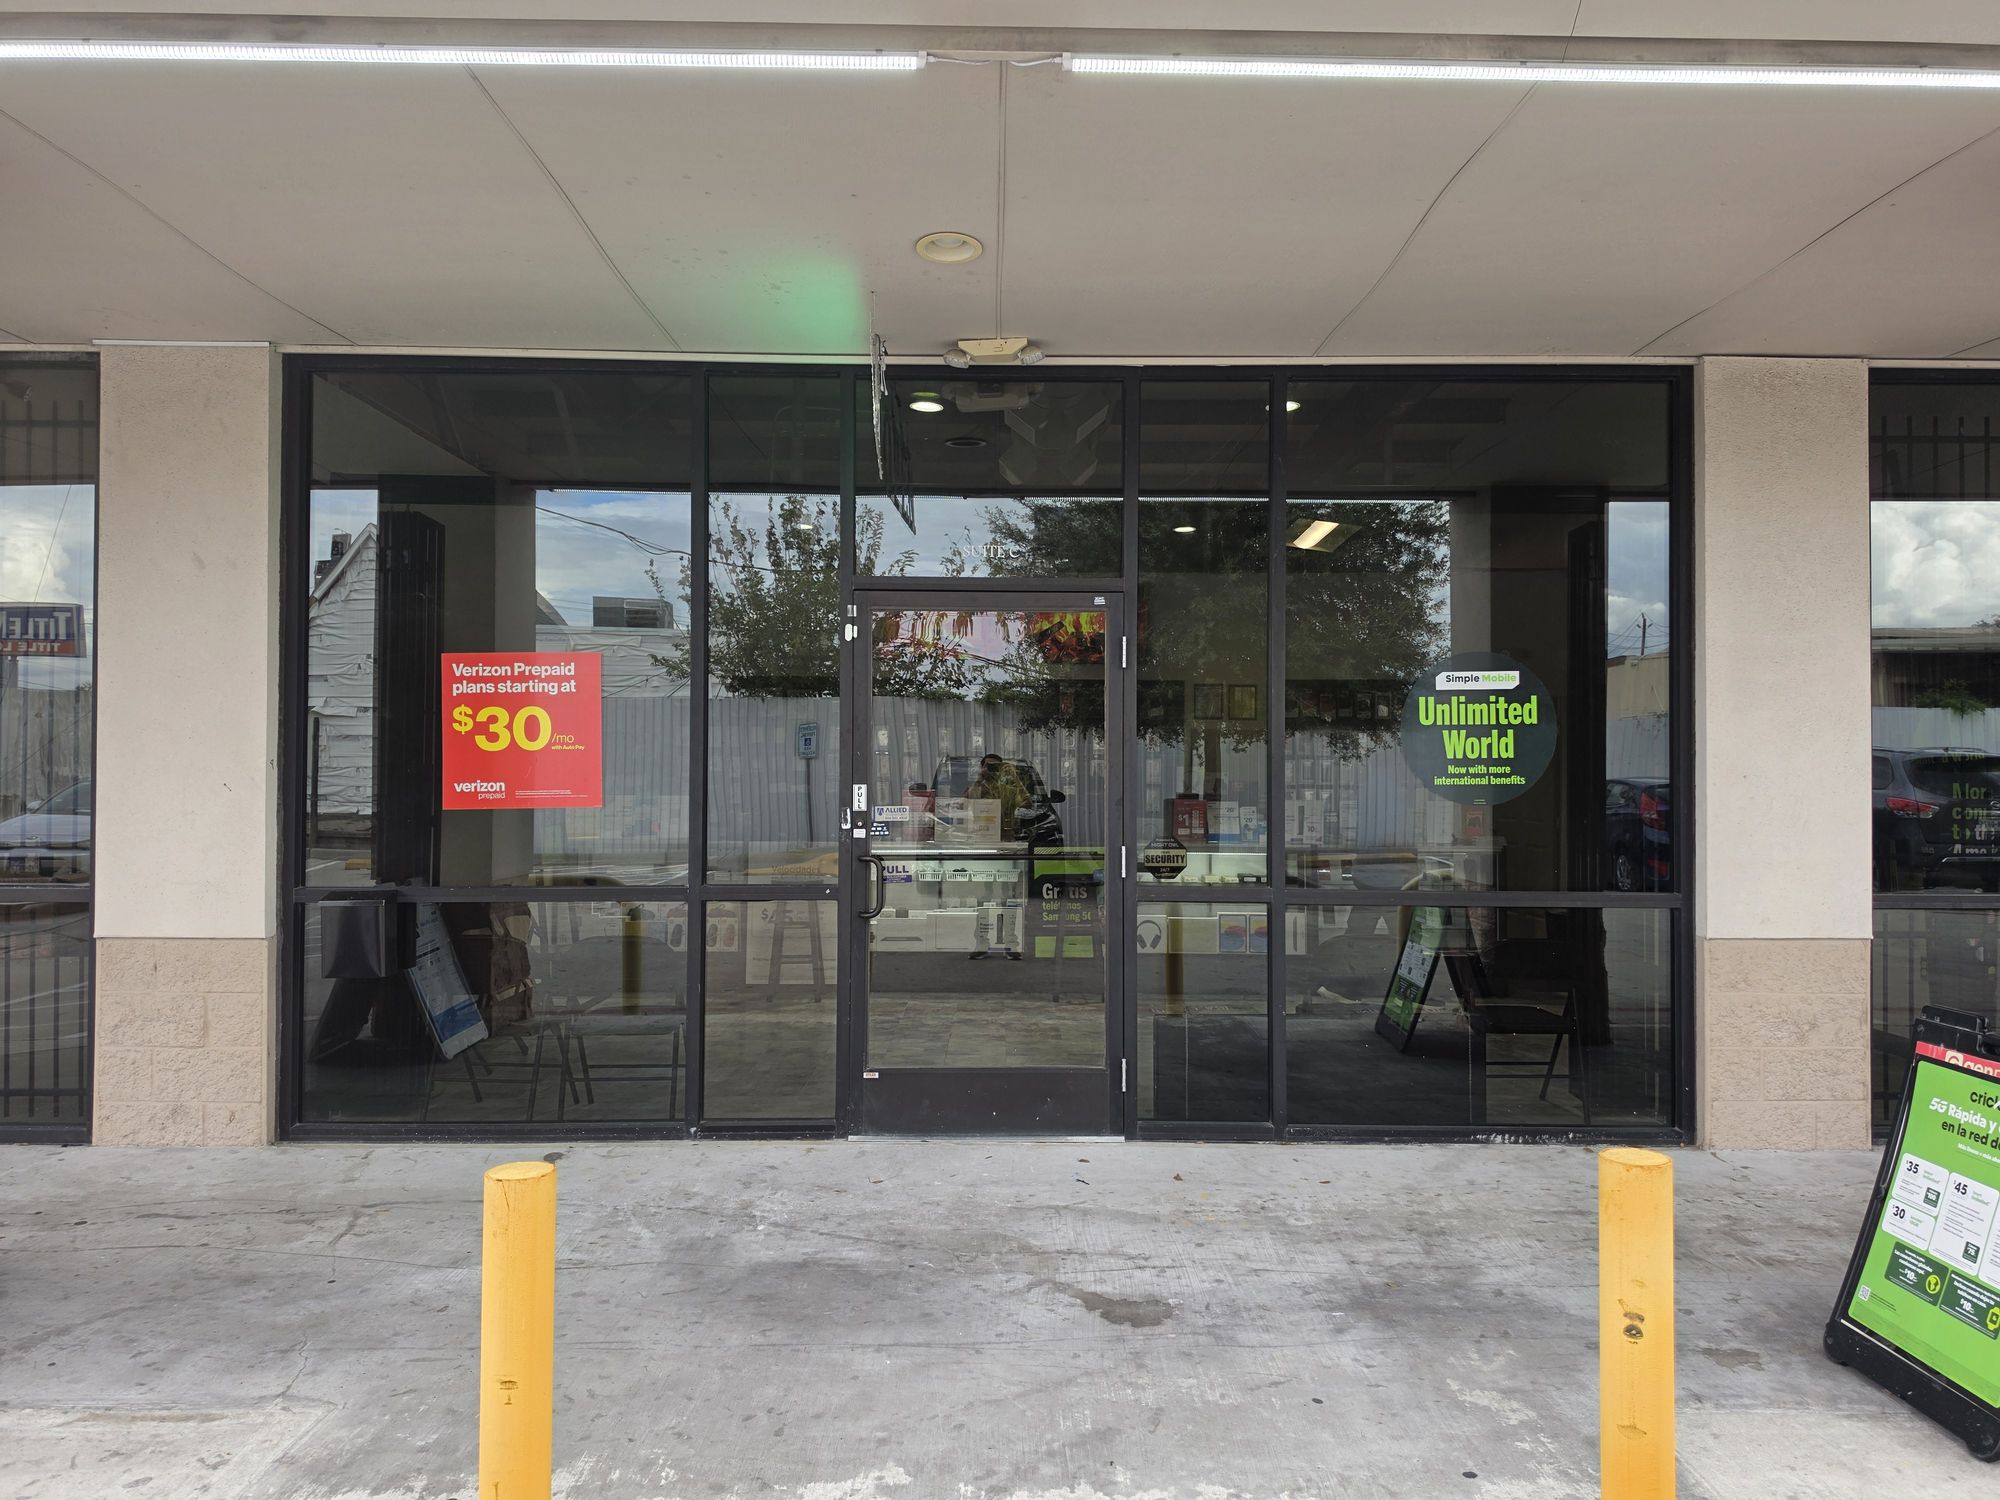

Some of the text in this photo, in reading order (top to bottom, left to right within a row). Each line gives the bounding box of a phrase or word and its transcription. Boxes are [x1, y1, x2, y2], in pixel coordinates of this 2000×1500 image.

[962, 545, 1020, 558] SUITE C
[452, 662, 575, 679] Verizon Prepaid
[1445, 674, 1516, 684] Simple Mobile
[452, 680, 576, 696] plans starting at
[1418, 695, 1538, 726] Unlimited
[452, 704, 552, 752] $30
[1442, 729, 1514, 759] World
[1448, 764, 1511, 774] Now with more
[454, 780, 505, 792] verizon
[1434, 775, 1526, 785] international benefits
[478, 792, 505, 800] prepaid
[1145, 854, 1186, 864] SECURITY
[1042, 883, 1088, 899] Grtis
[1929, 1097, 1998, 1134] 5G Rápida y
[1941, 1121, 2000, 1151] en la red d
